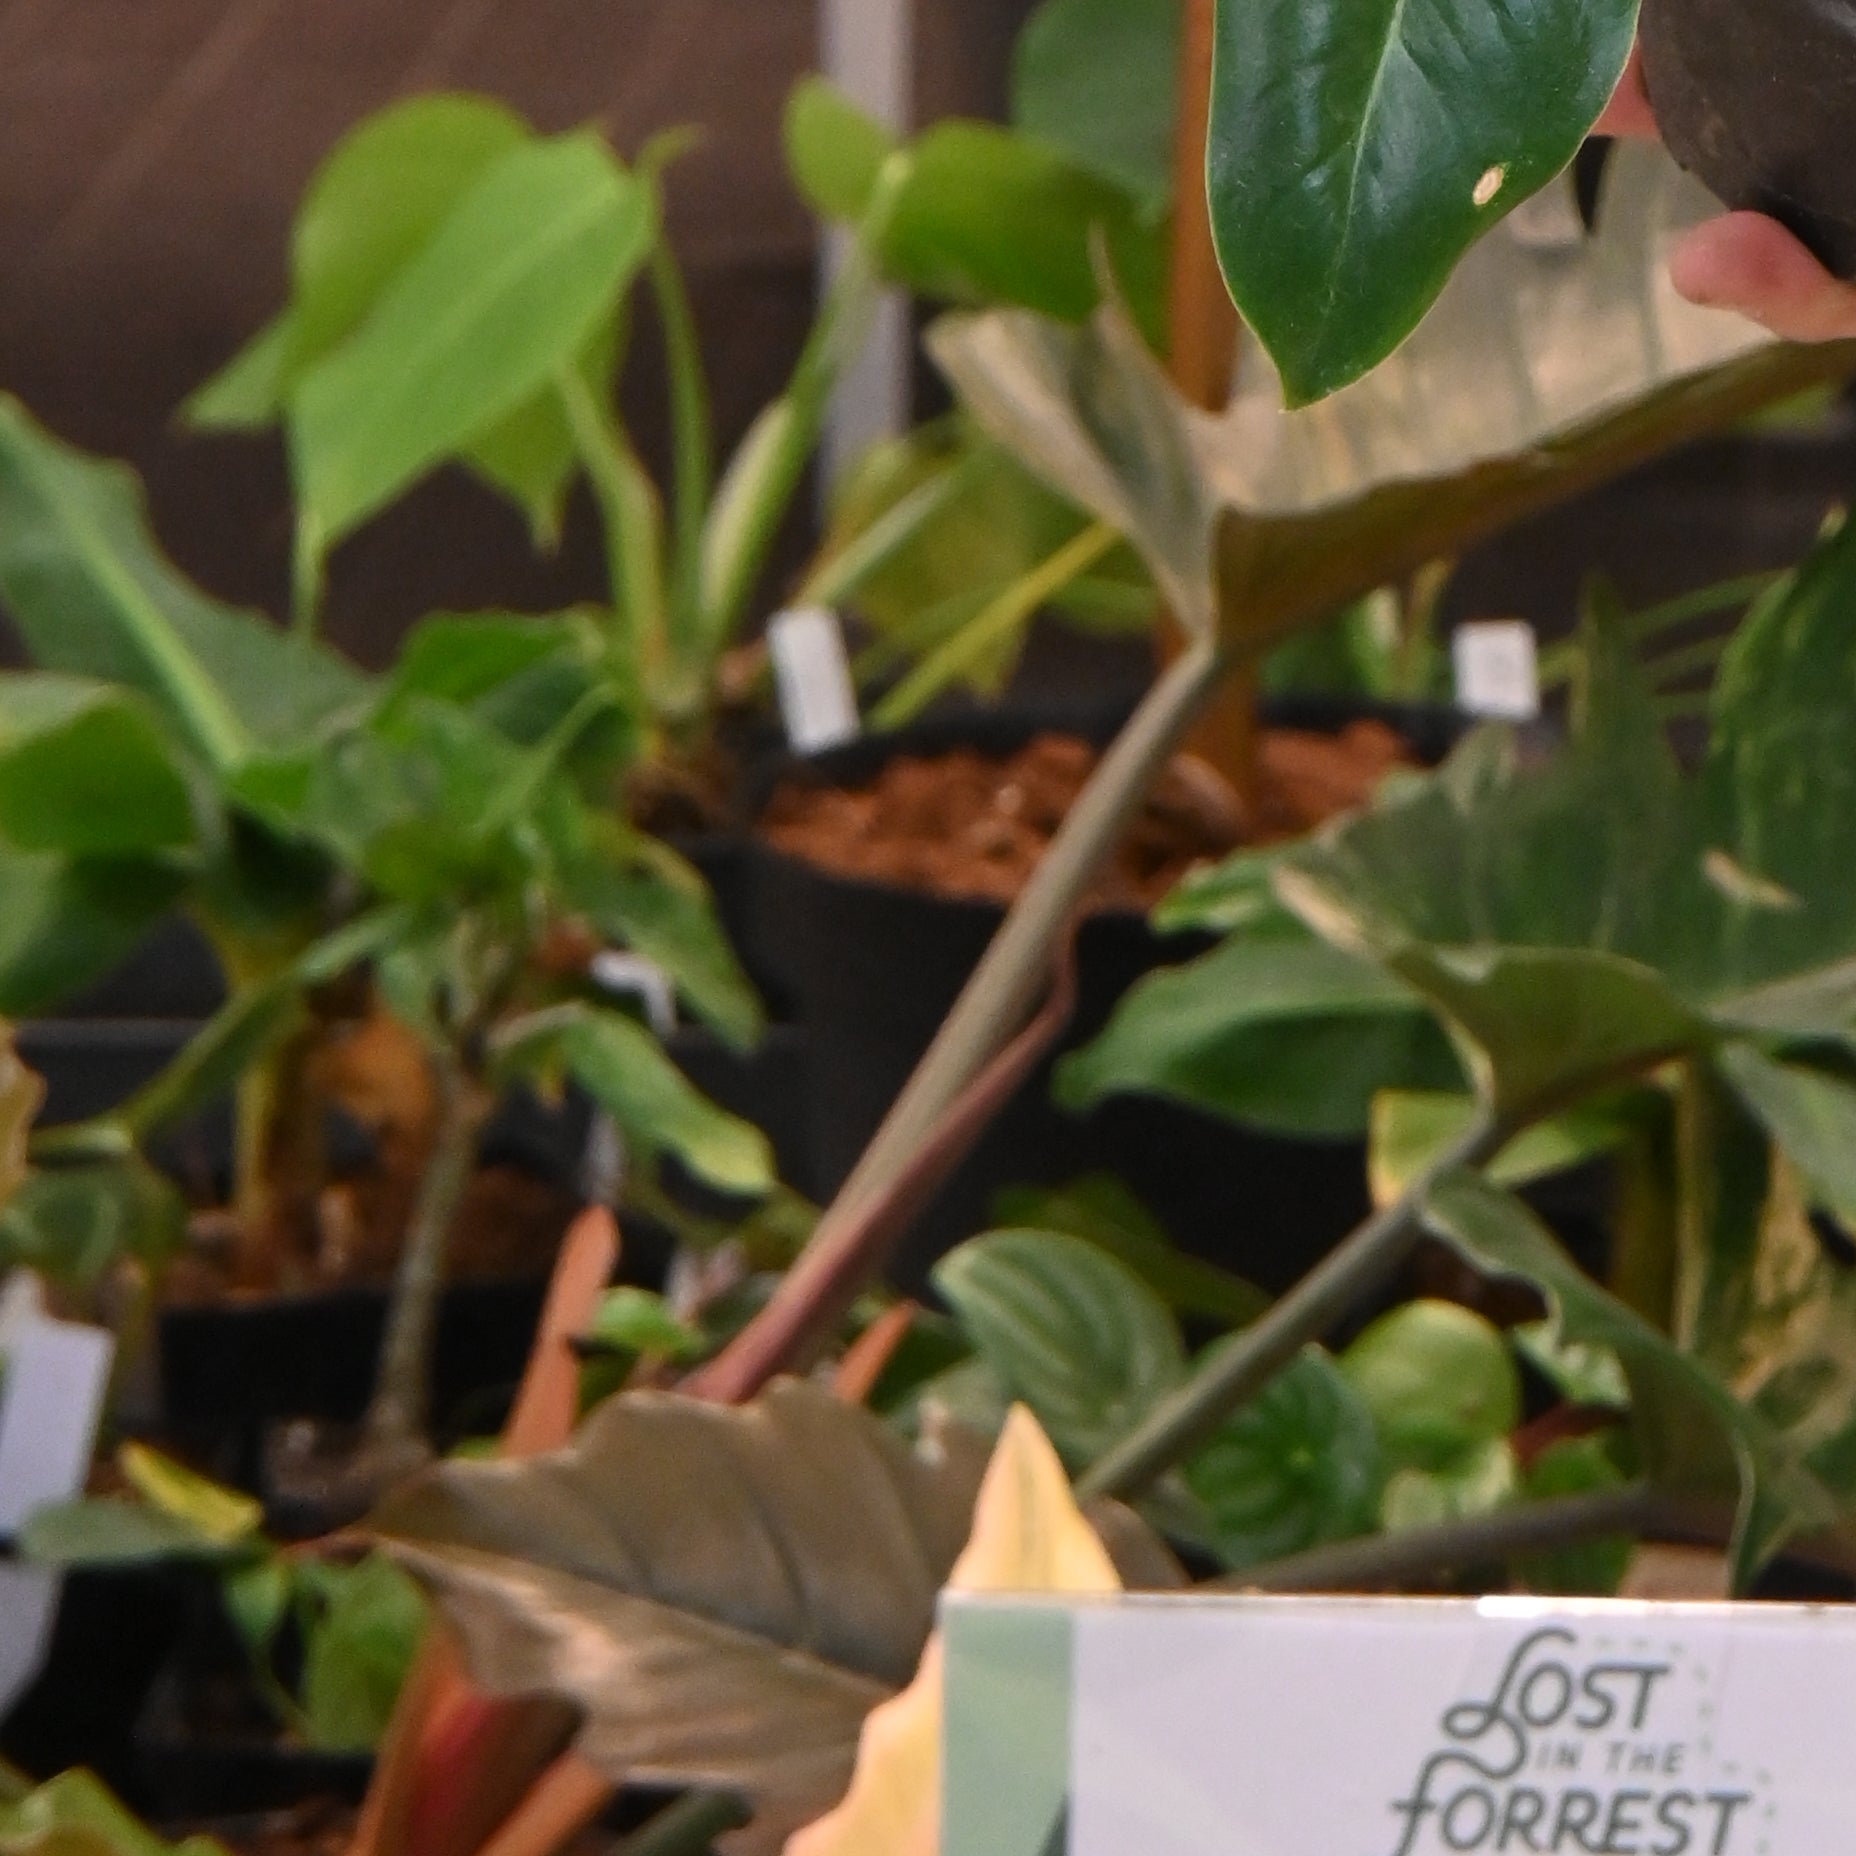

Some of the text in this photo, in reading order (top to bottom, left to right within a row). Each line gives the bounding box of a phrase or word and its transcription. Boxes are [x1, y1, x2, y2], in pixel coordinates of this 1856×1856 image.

[1441, 1626, 1672, 1740] LOST
[1535, 1738, 1688, 1773] IN THE
